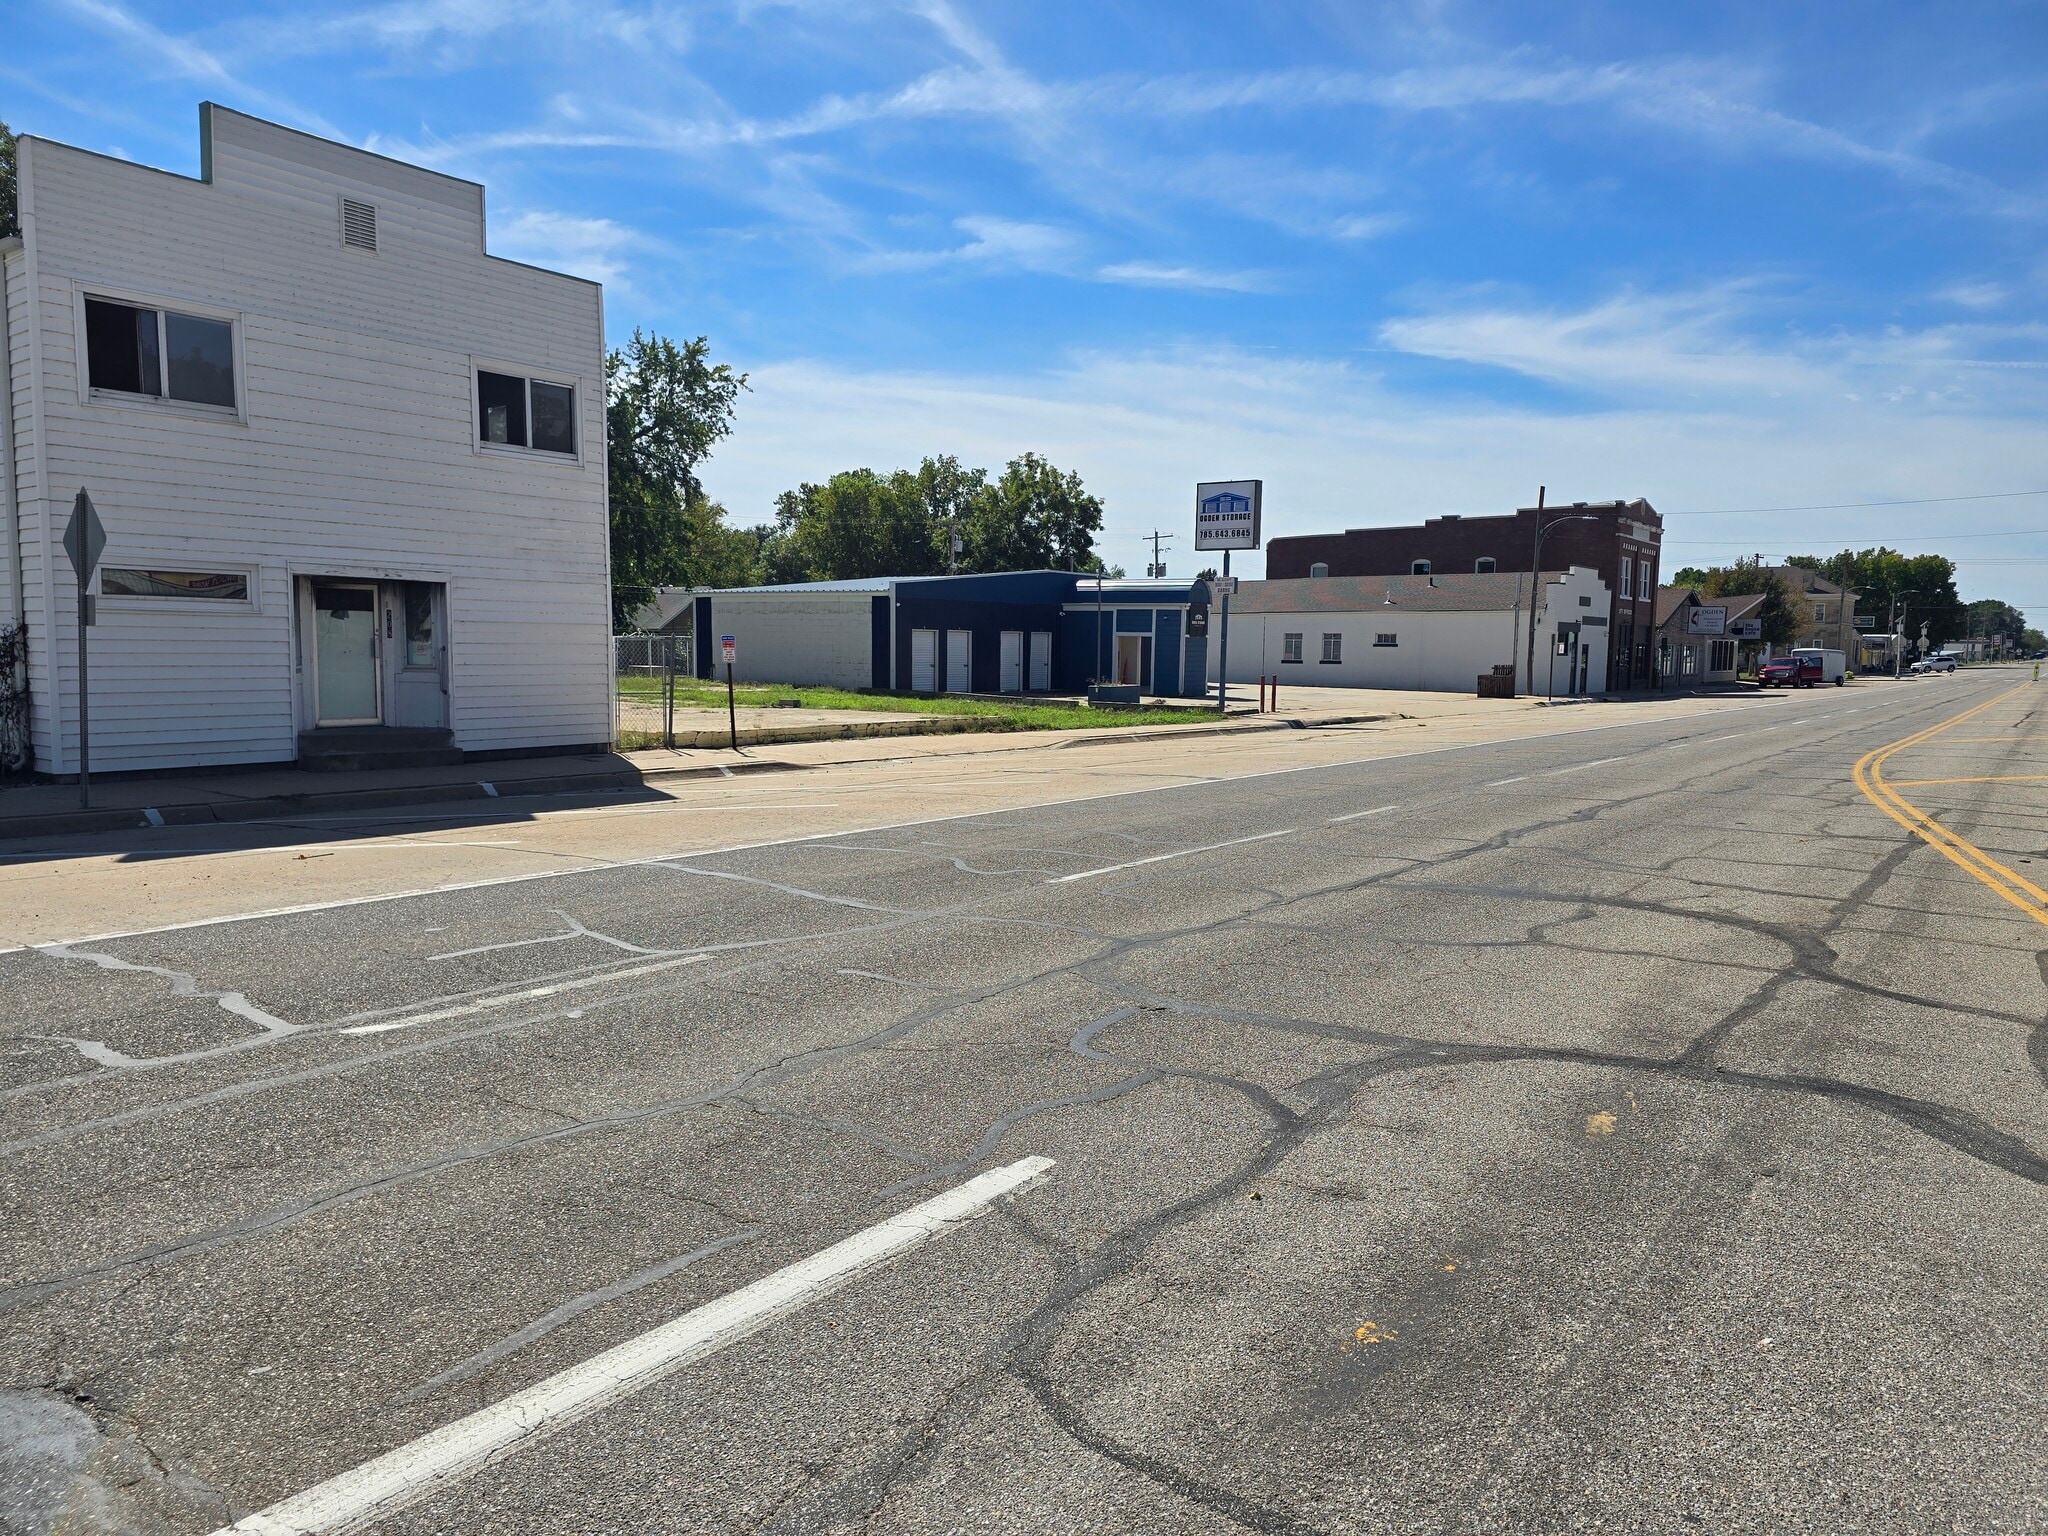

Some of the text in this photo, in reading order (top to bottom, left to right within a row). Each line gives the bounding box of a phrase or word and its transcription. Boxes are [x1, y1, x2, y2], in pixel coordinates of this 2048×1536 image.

[1200, 513, 1251, 522] OGDEN STORAGE
[1200, 529, 1250, 538] 785.643.6845
